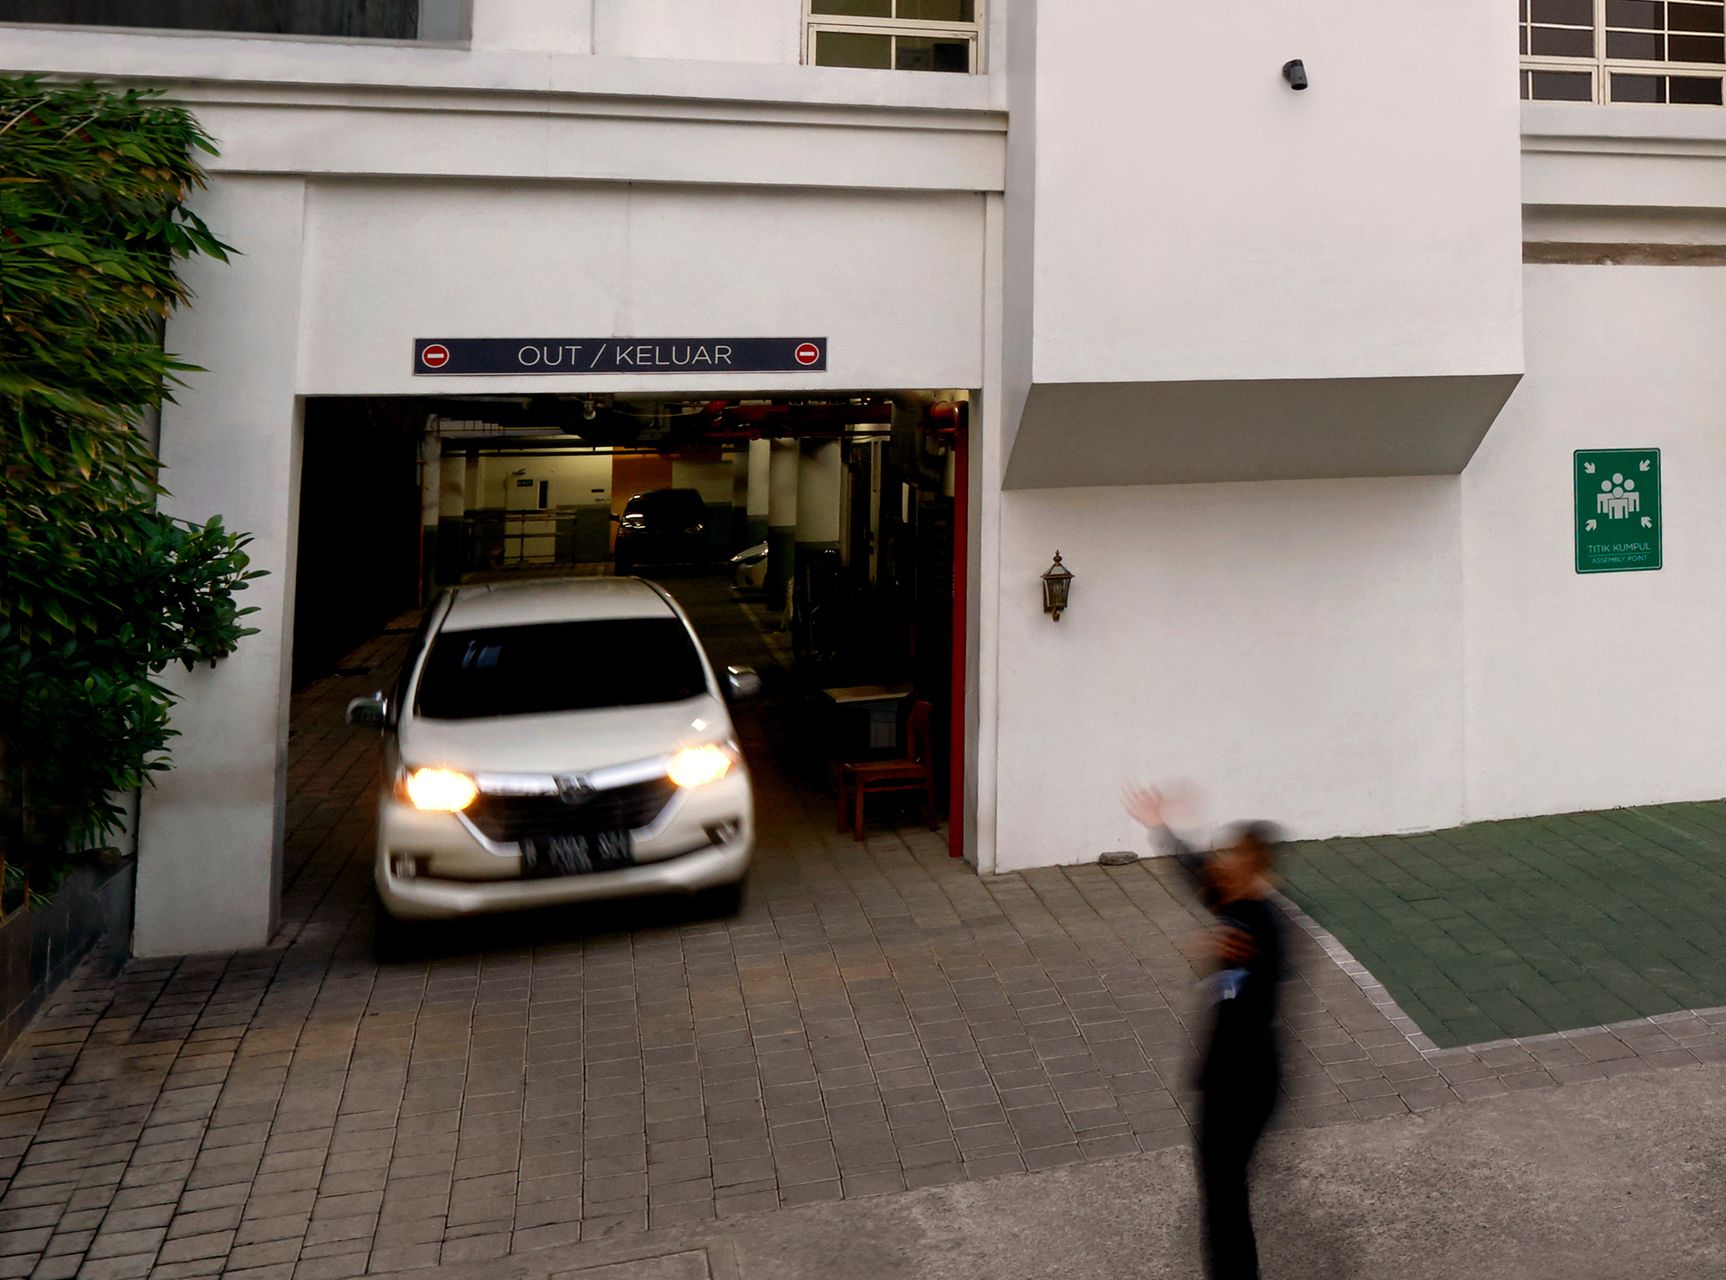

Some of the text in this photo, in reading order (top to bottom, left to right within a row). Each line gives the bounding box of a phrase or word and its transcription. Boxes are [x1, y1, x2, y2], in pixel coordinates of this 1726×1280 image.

[518, 343, 732, 368] OUT / KELUAR
[1613, 542, 1651, 552] KUMPUL
